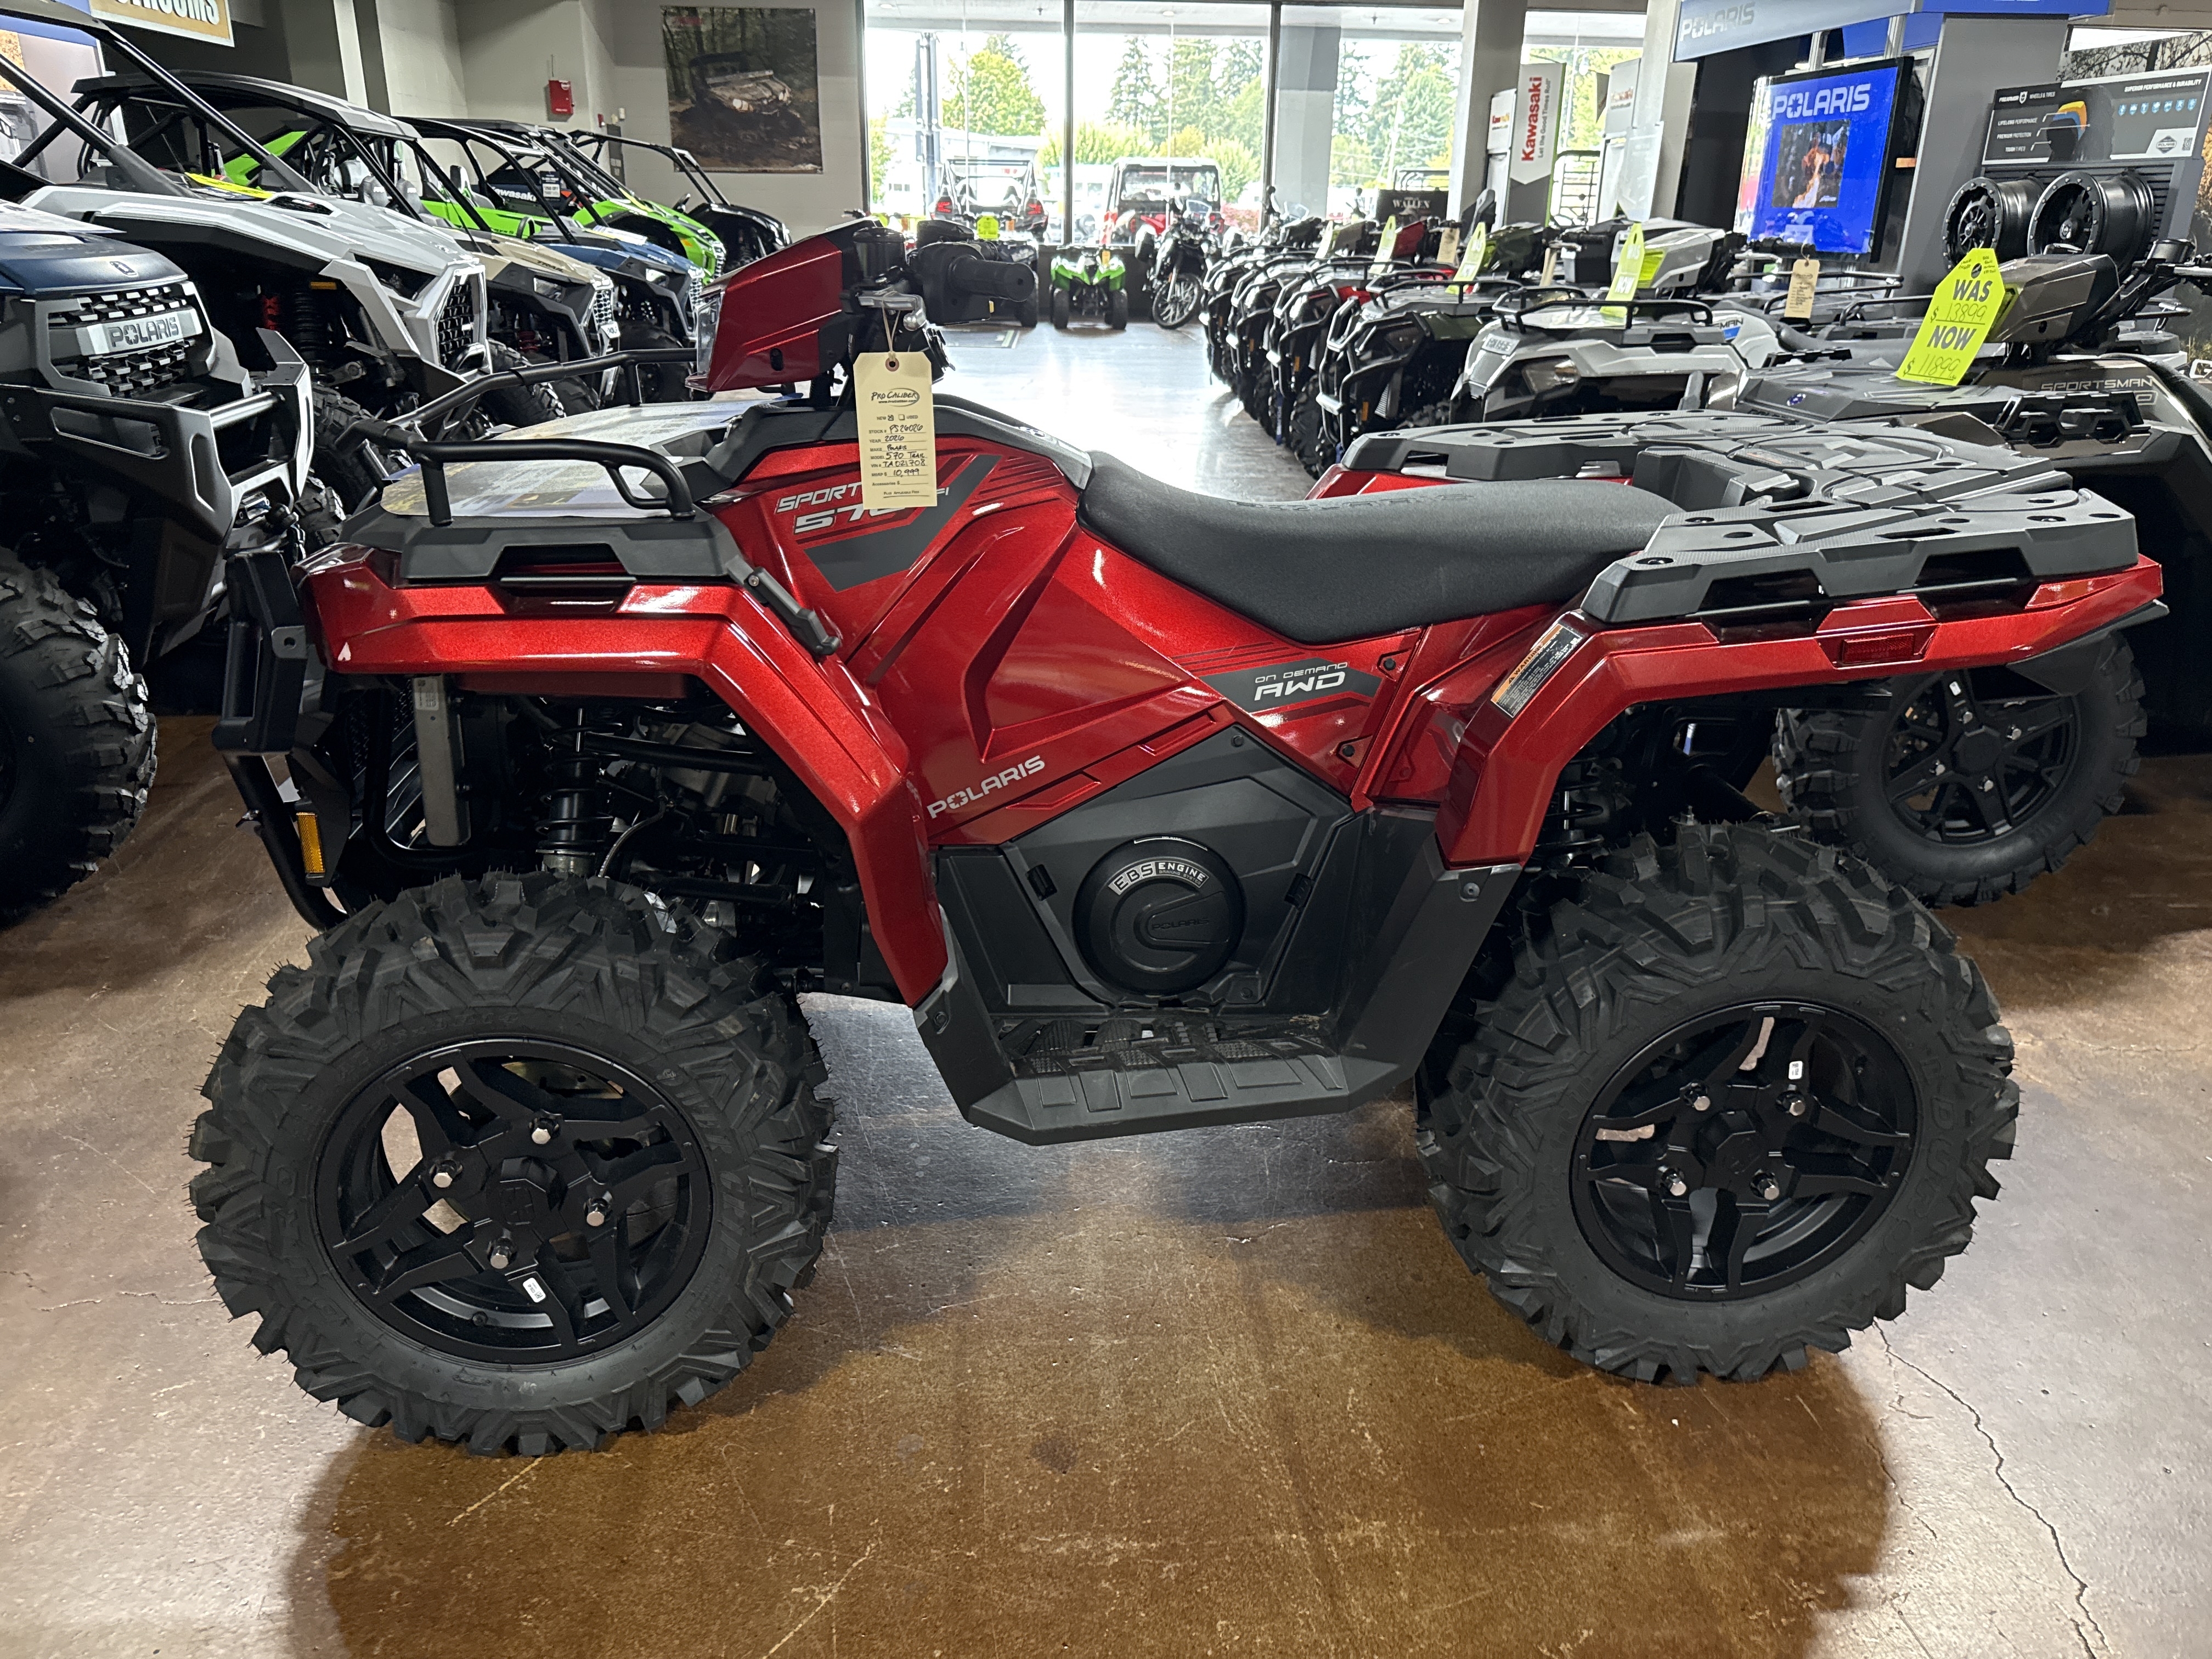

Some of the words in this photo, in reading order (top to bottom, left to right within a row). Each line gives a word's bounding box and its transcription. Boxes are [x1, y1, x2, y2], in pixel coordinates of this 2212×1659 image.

[1680, 1, 1756, 42] POLARIS
[2143, 82, 2172, 91] PERFORMANCE
[2176, 79, 2202, 87] DURABILITY
[1542, 95, 1550, 115] Times
[1771, 83, 1871, 120] POLARIS
[1521, 76, 1543, 161] Kawasaki
[1953, 279, 1993, 302] WAS
[1930, 306, 1939, 323] $
[1945, 302, 1988, 323] 13899
[108, 317, 179, 347] POLARIS
[1927, 325, 1977, 351] NOW
[1903, 358, 1915, 377] $
[871, 392, 886, 401] PRO
[887, 391, 917, 399] CALIBER
[2041, 378, 2153, 391] SPORTSMAN
[893, 469, 919, 477] 10,999
[777, 482, 862, 513] SPORT
[1514, 642, 1544, 675] WARNING
[1255, 675, 1276, 683] ON
[1283, 662, 1348, 679] DEMAND
[1254, 671, 1346, 701] AWD
[927, 755, 1045, 819] POLARIS
[1113, 863, 1154, 891] EBS
[1158, 862, 1206, 882] ENGINE
[1152, 918, 1209, 932] POLARIS
